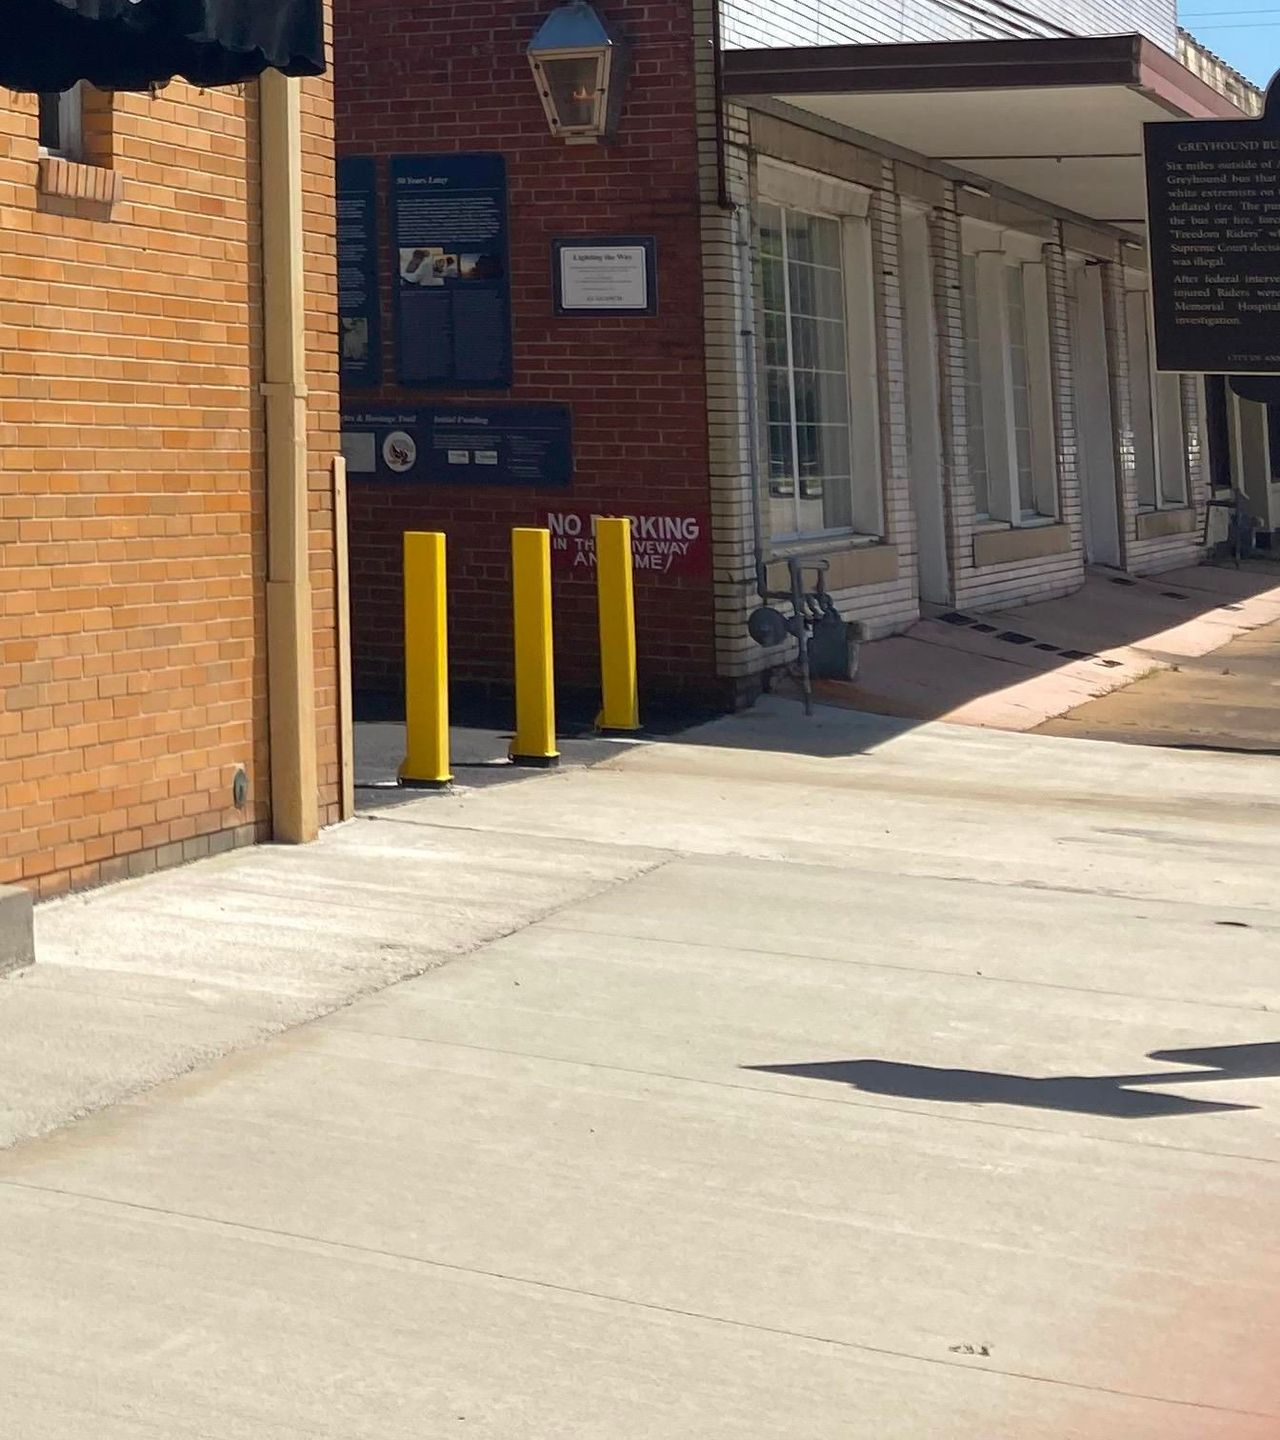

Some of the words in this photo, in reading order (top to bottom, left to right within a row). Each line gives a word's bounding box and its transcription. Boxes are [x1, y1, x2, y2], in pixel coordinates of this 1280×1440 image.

[1177, 140, 1259, 152] GREYHOUND
[1166, 161, 1183, 171] Six
[1186, 161, 1215, 171] miles
[1217, 160, 1258, 169] outside
[1260, 160, 1273, 169] of
[1166, 173, 1227, 185] Greyhound
[1231, 173, 1250, 183] bus
[1255, 172, 1277, 183] that
[1168, 188, 1197, 198] white
[1200, 189, 1256, 198] extremists
[1168, 201, 1210, 211] deflated
[1240, 201, 1260, 211] The
[1169, 216, 1186, 225] the
[1191, 216, 1209, 225] bus
[1170, 244, 1215, 255] Supreme
[1217, 243, 1248, 252] Court
[1174, 274, 1199, 283] After
[1205, 274, 1240, 283] federal
[1174, 288, 1210, 299] injured
[1217, 288, 1250, 297] Riders
[1175, 301, 1224, 311] Memorial
[548, 513, 582, 536] NO
[590, 514, 699, 540] PRKING
[553, 538, 567, 551] IN
